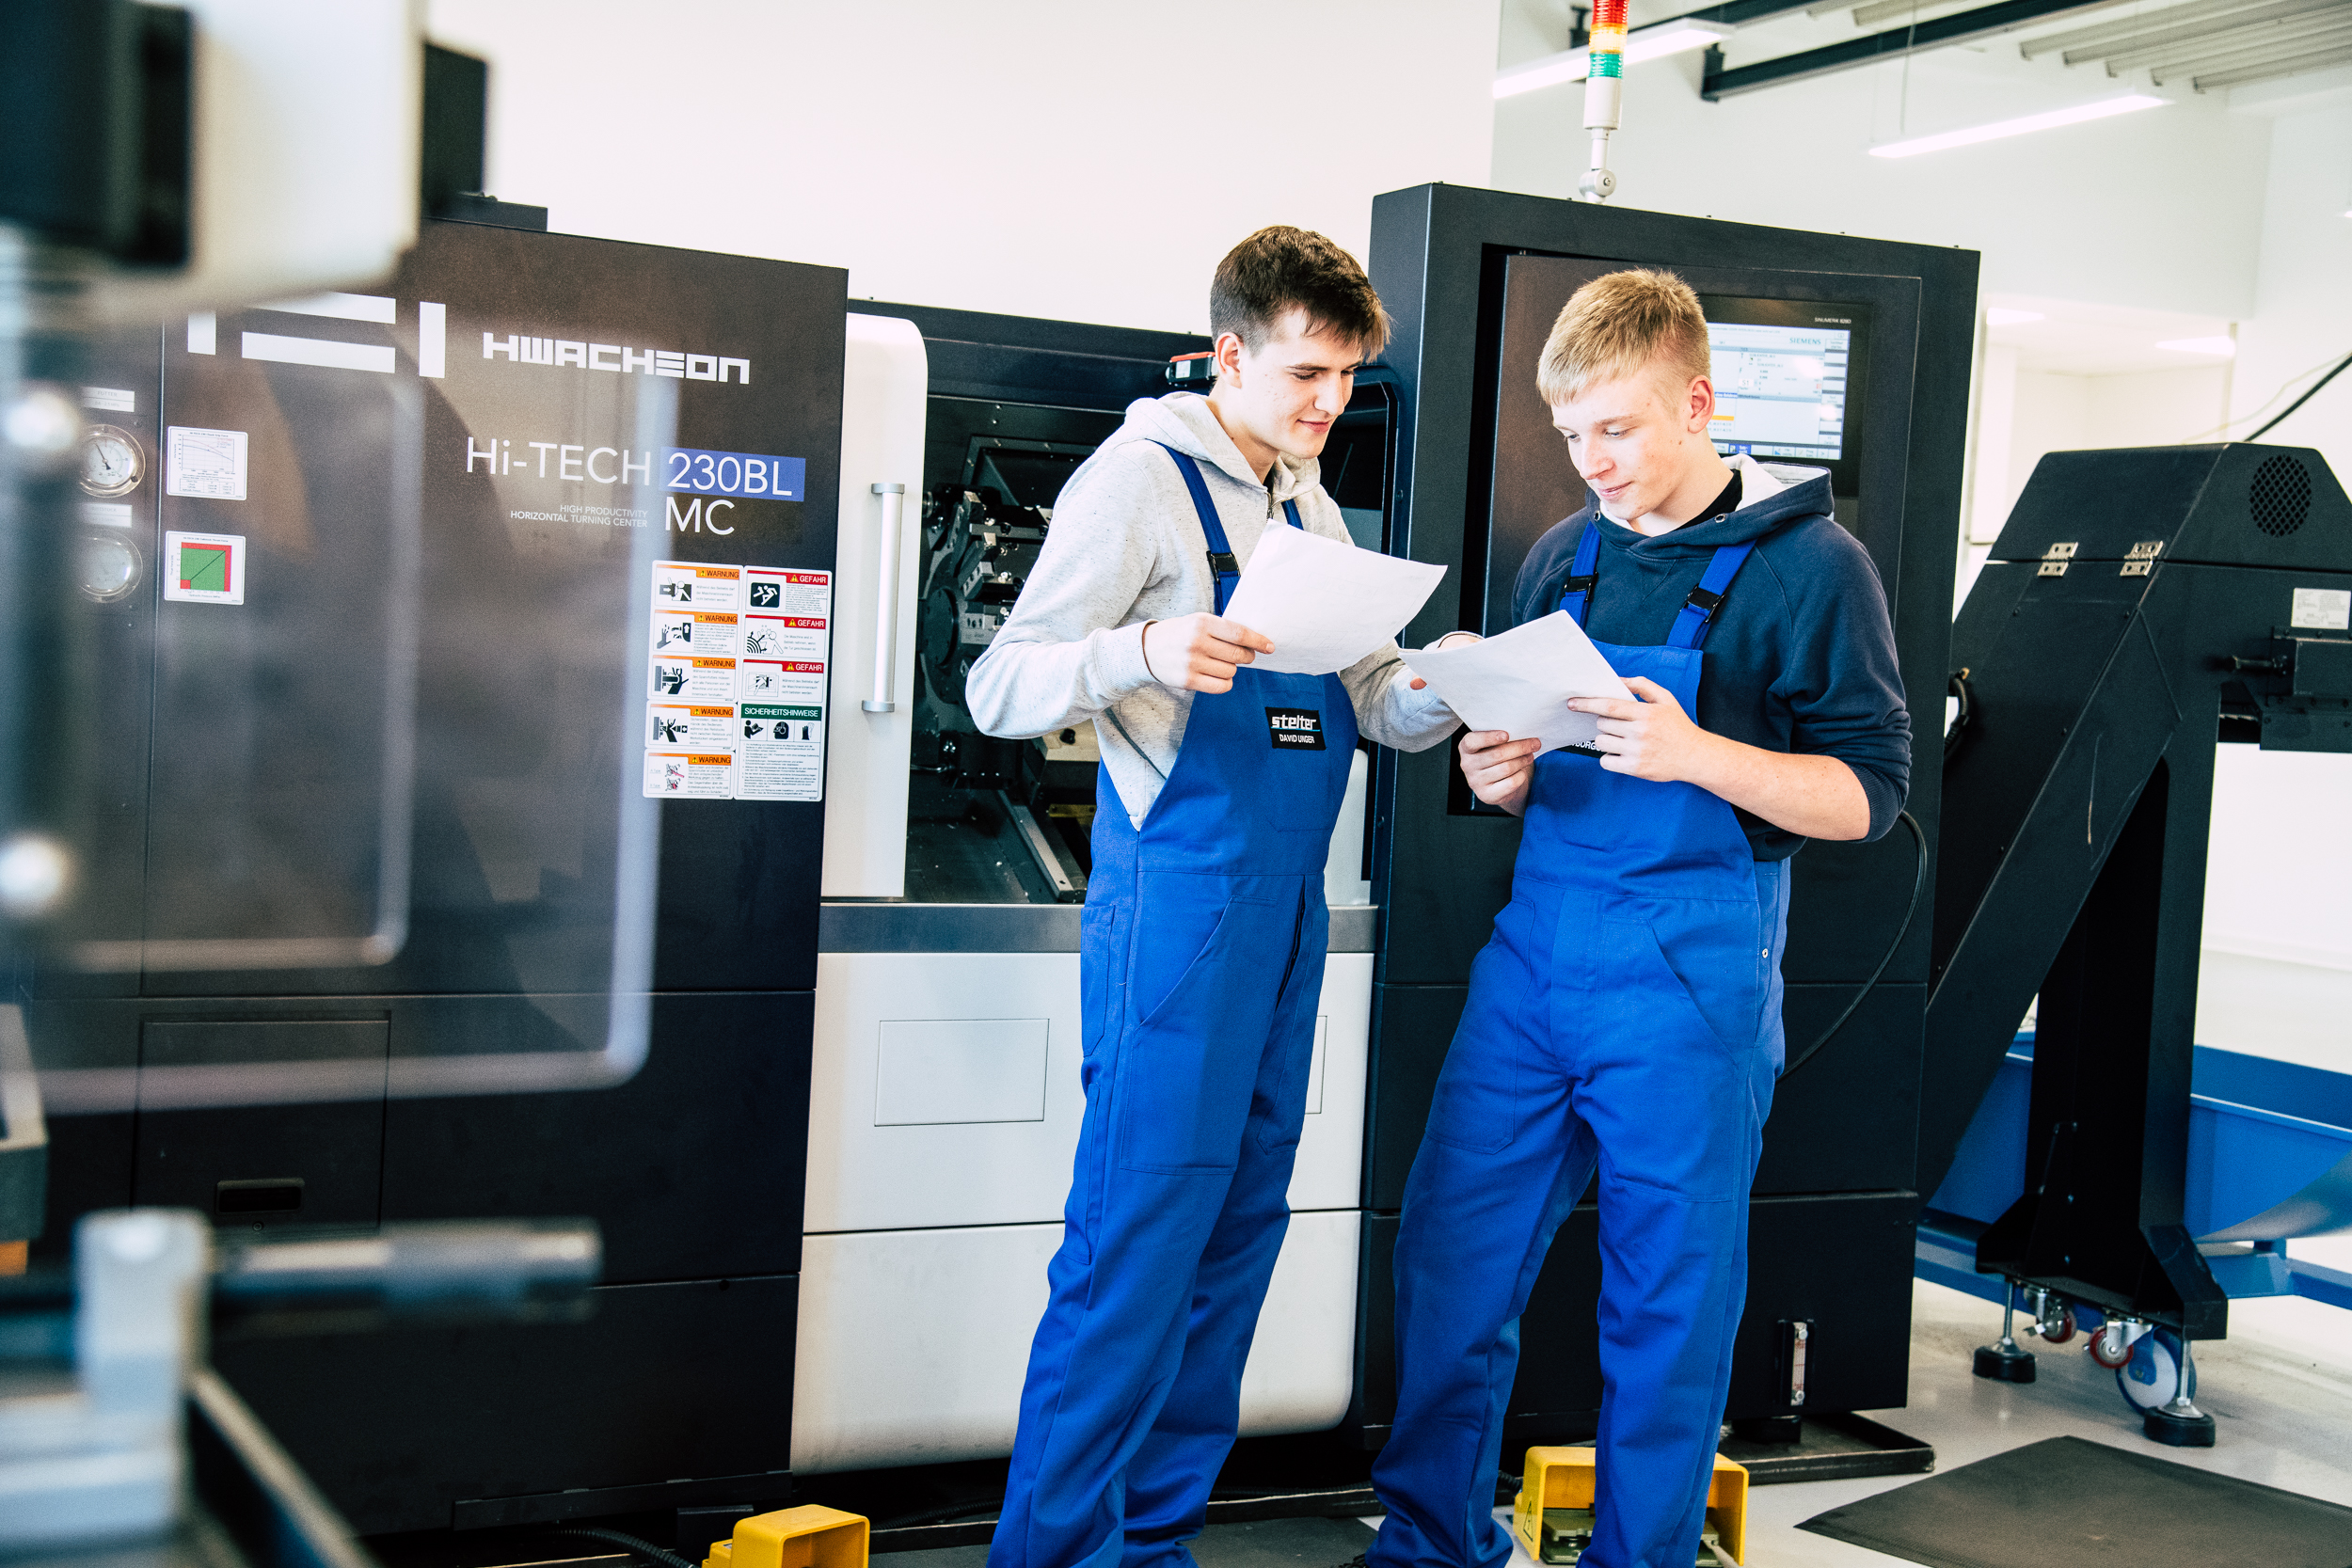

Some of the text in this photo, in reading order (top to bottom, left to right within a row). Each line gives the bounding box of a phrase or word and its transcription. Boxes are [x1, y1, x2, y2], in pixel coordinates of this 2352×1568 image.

[1789, 337, 1821, 345] SIEMENS
[483, 332, 750, 384] HWACHEON
[467, 436, 792, 497] Hi-TECH 230BL
[560, 504, 648, 518] HIGH PRODUCTIVITY
[665, 496, 735, 535] MC
[510, 511, 648, 528] HORIZONTAL TURNING CENTER
[707, 570, 739, 578] WARNUNG
[799, 575, 826, 583] GEFAHR
[705, 614, 738, 623] WARNUNG
[797, 619, 824, 627] GEFAHR
[703, 659, 736, 668] WARNUNG
[795, 663, 822, 672] GEFAHR
[744, 707, 818, 718] SICHERHEITSHINWEISE
[1272, 714, 1317, 730] stelter
[1279, 734, 1315, 744] DAVID UNGER
